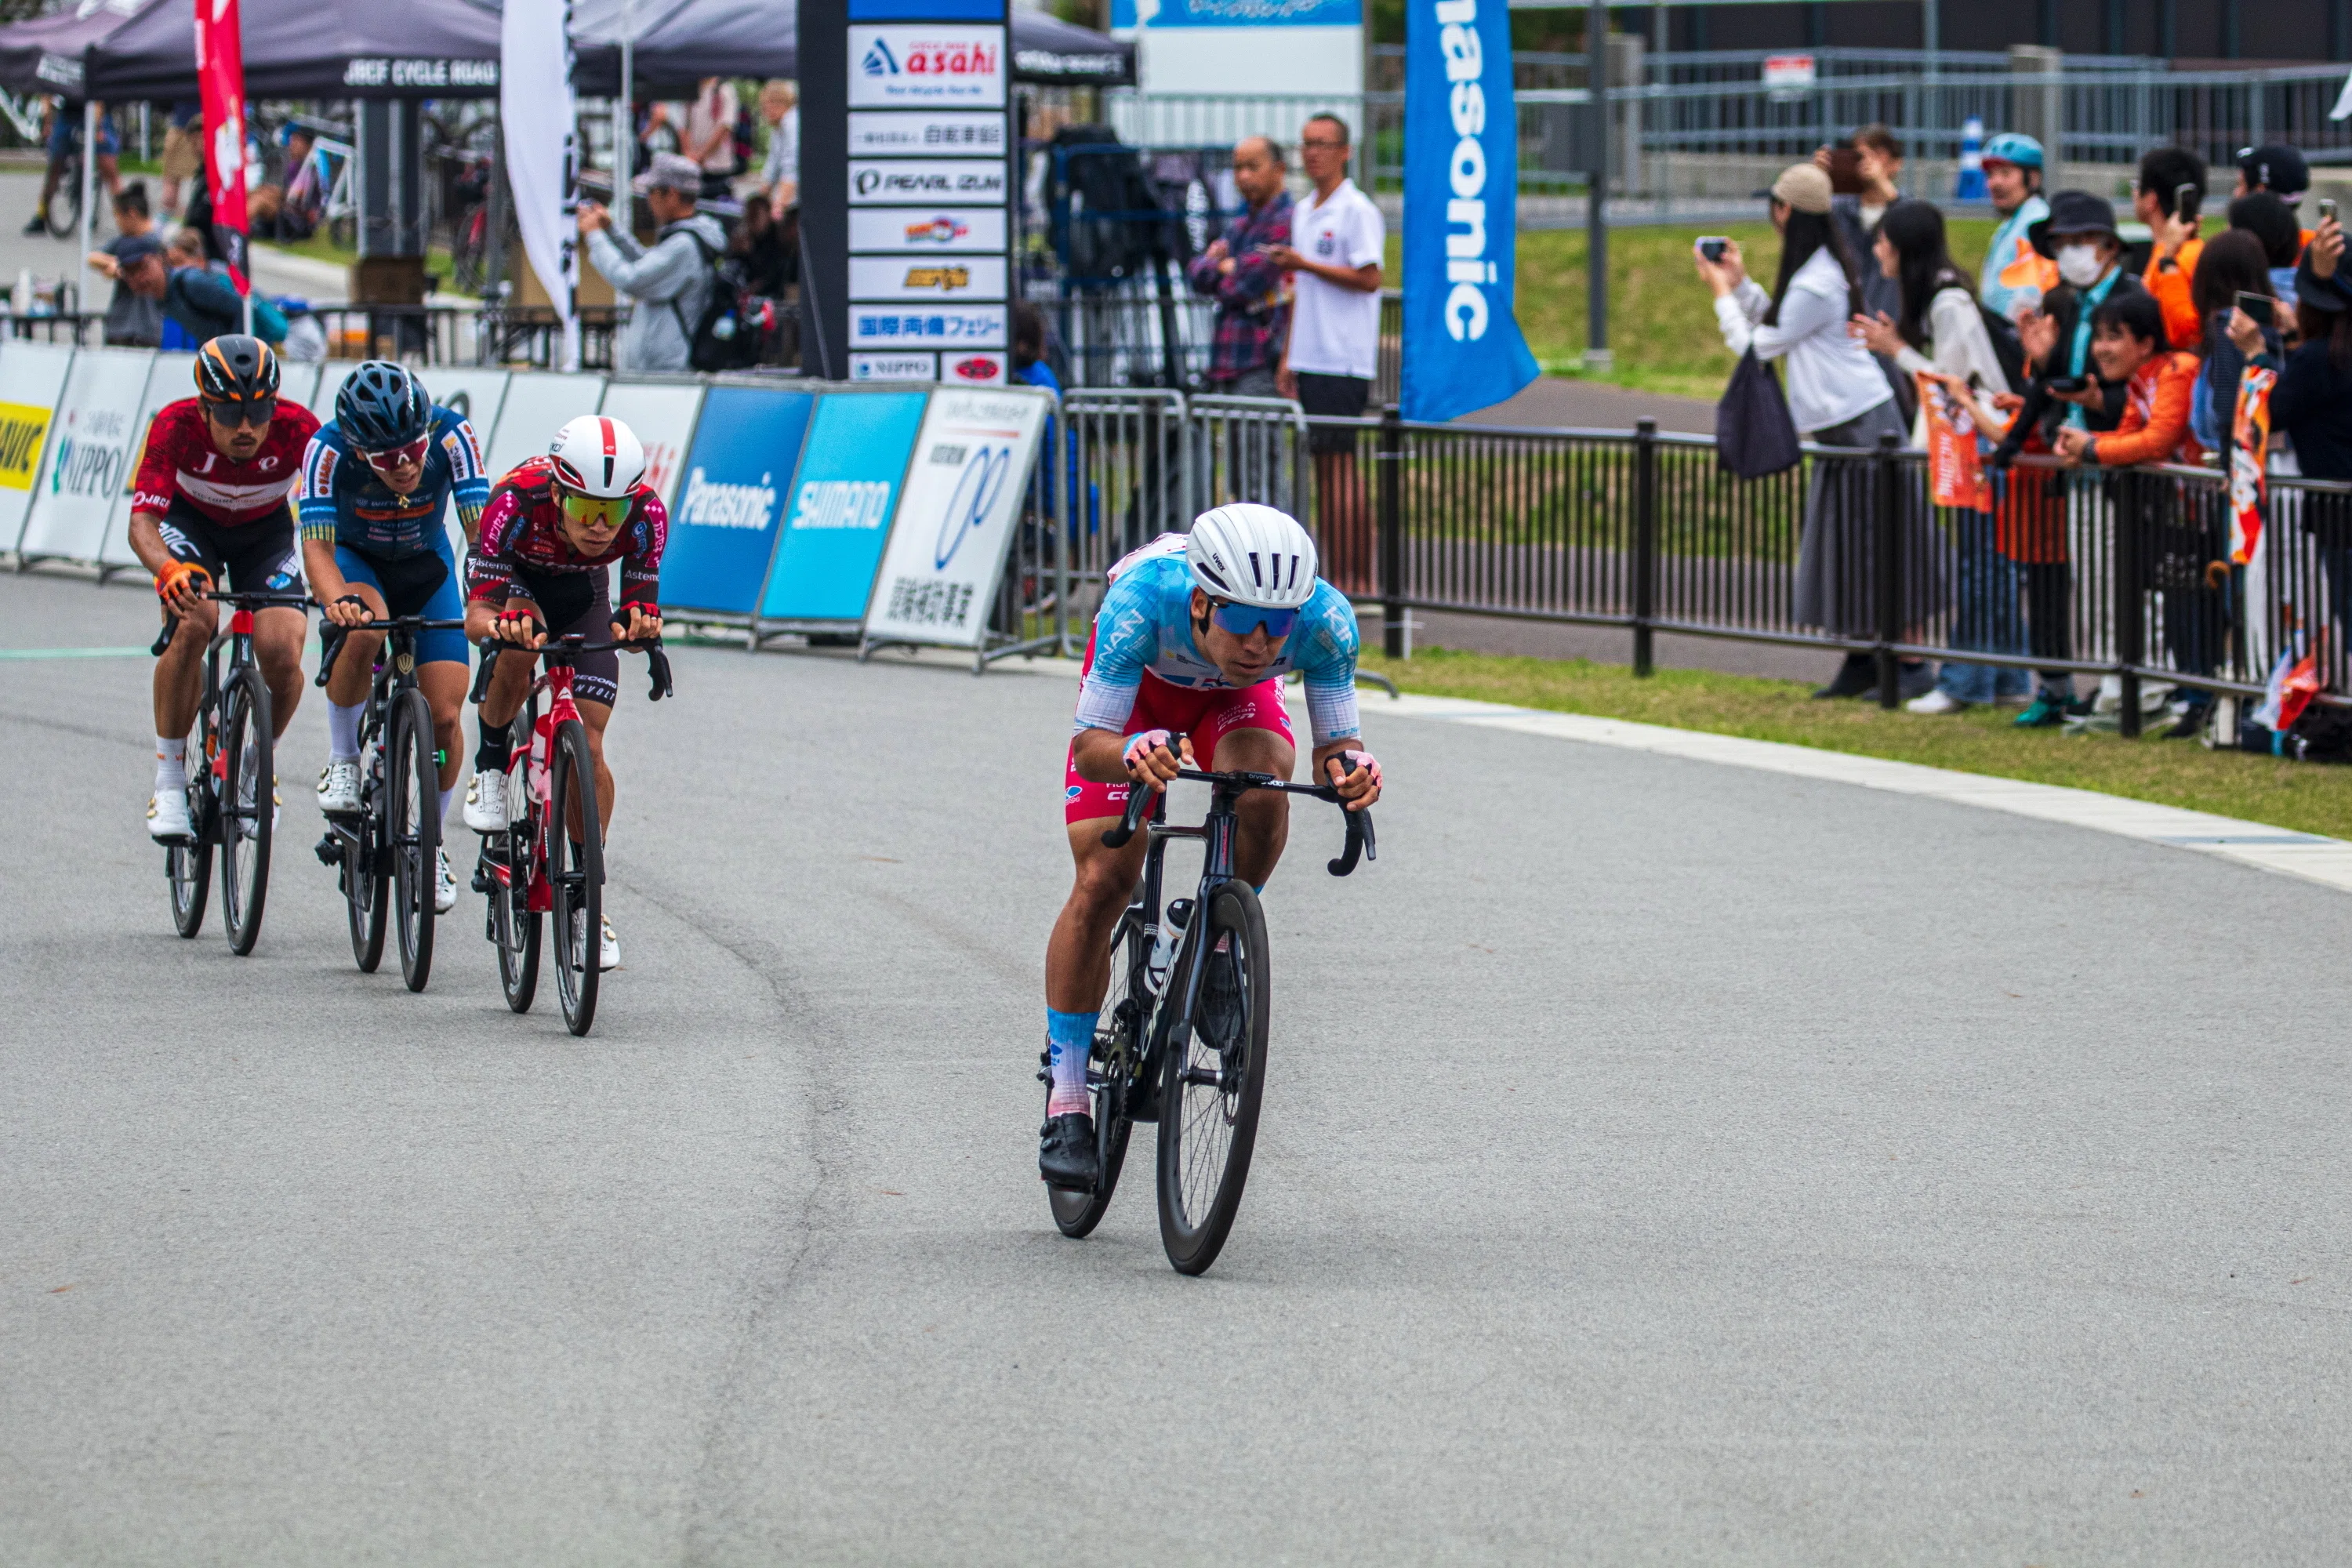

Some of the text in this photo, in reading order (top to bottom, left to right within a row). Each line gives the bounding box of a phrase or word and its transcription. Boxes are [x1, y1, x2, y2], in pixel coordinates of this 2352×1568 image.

[678, 466, 777, 532] Panasonic
[792, 479, 891, 530] SHIMANO
[1212, 553, 1226, 573] uvex
